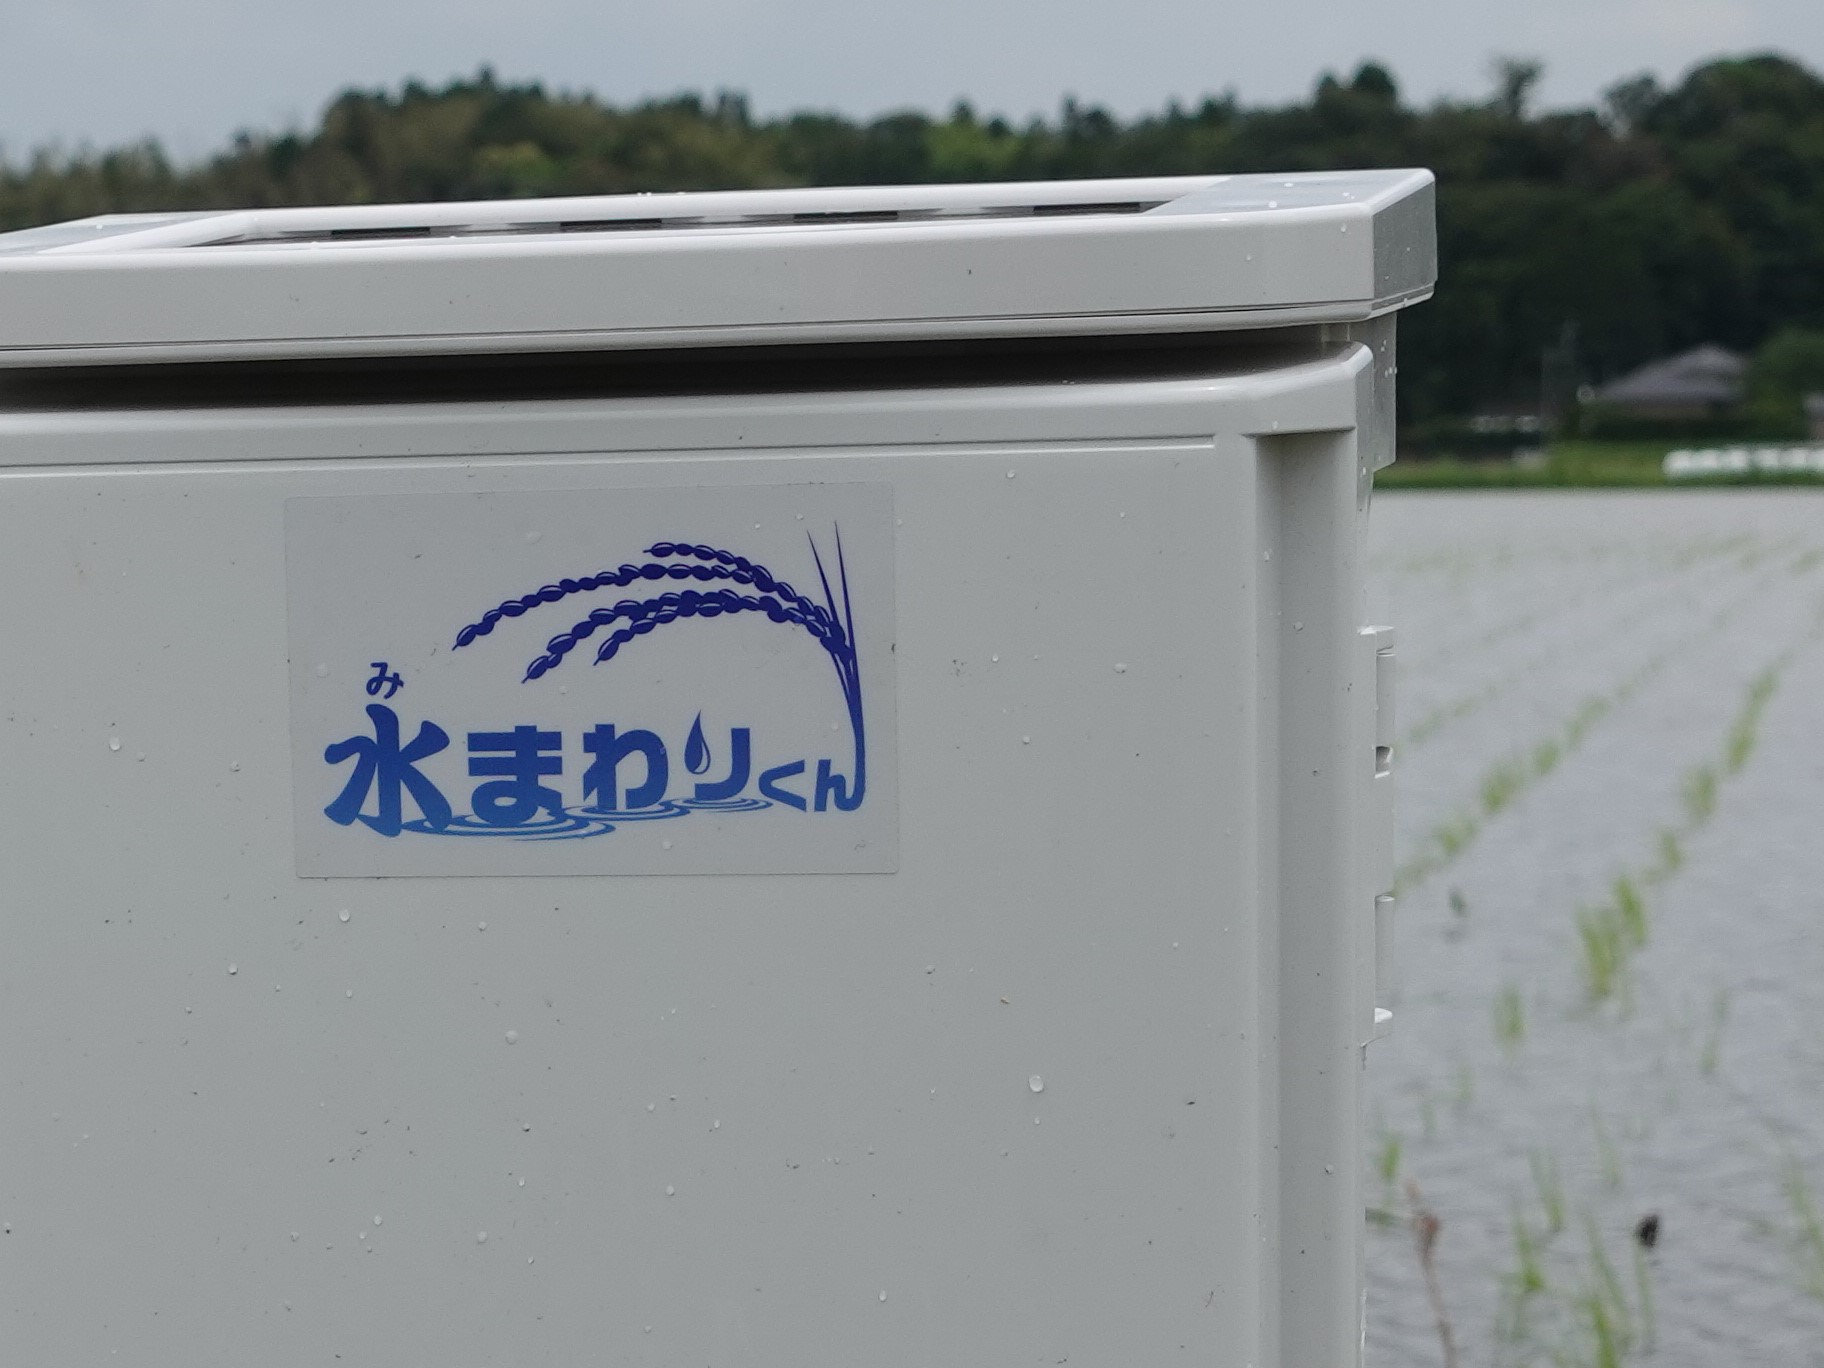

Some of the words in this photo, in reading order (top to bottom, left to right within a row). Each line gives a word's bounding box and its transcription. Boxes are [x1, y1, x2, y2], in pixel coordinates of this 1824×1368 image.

[365, 661, 404, 700] み
[323, 703, 866, 838] 水まわりくん
